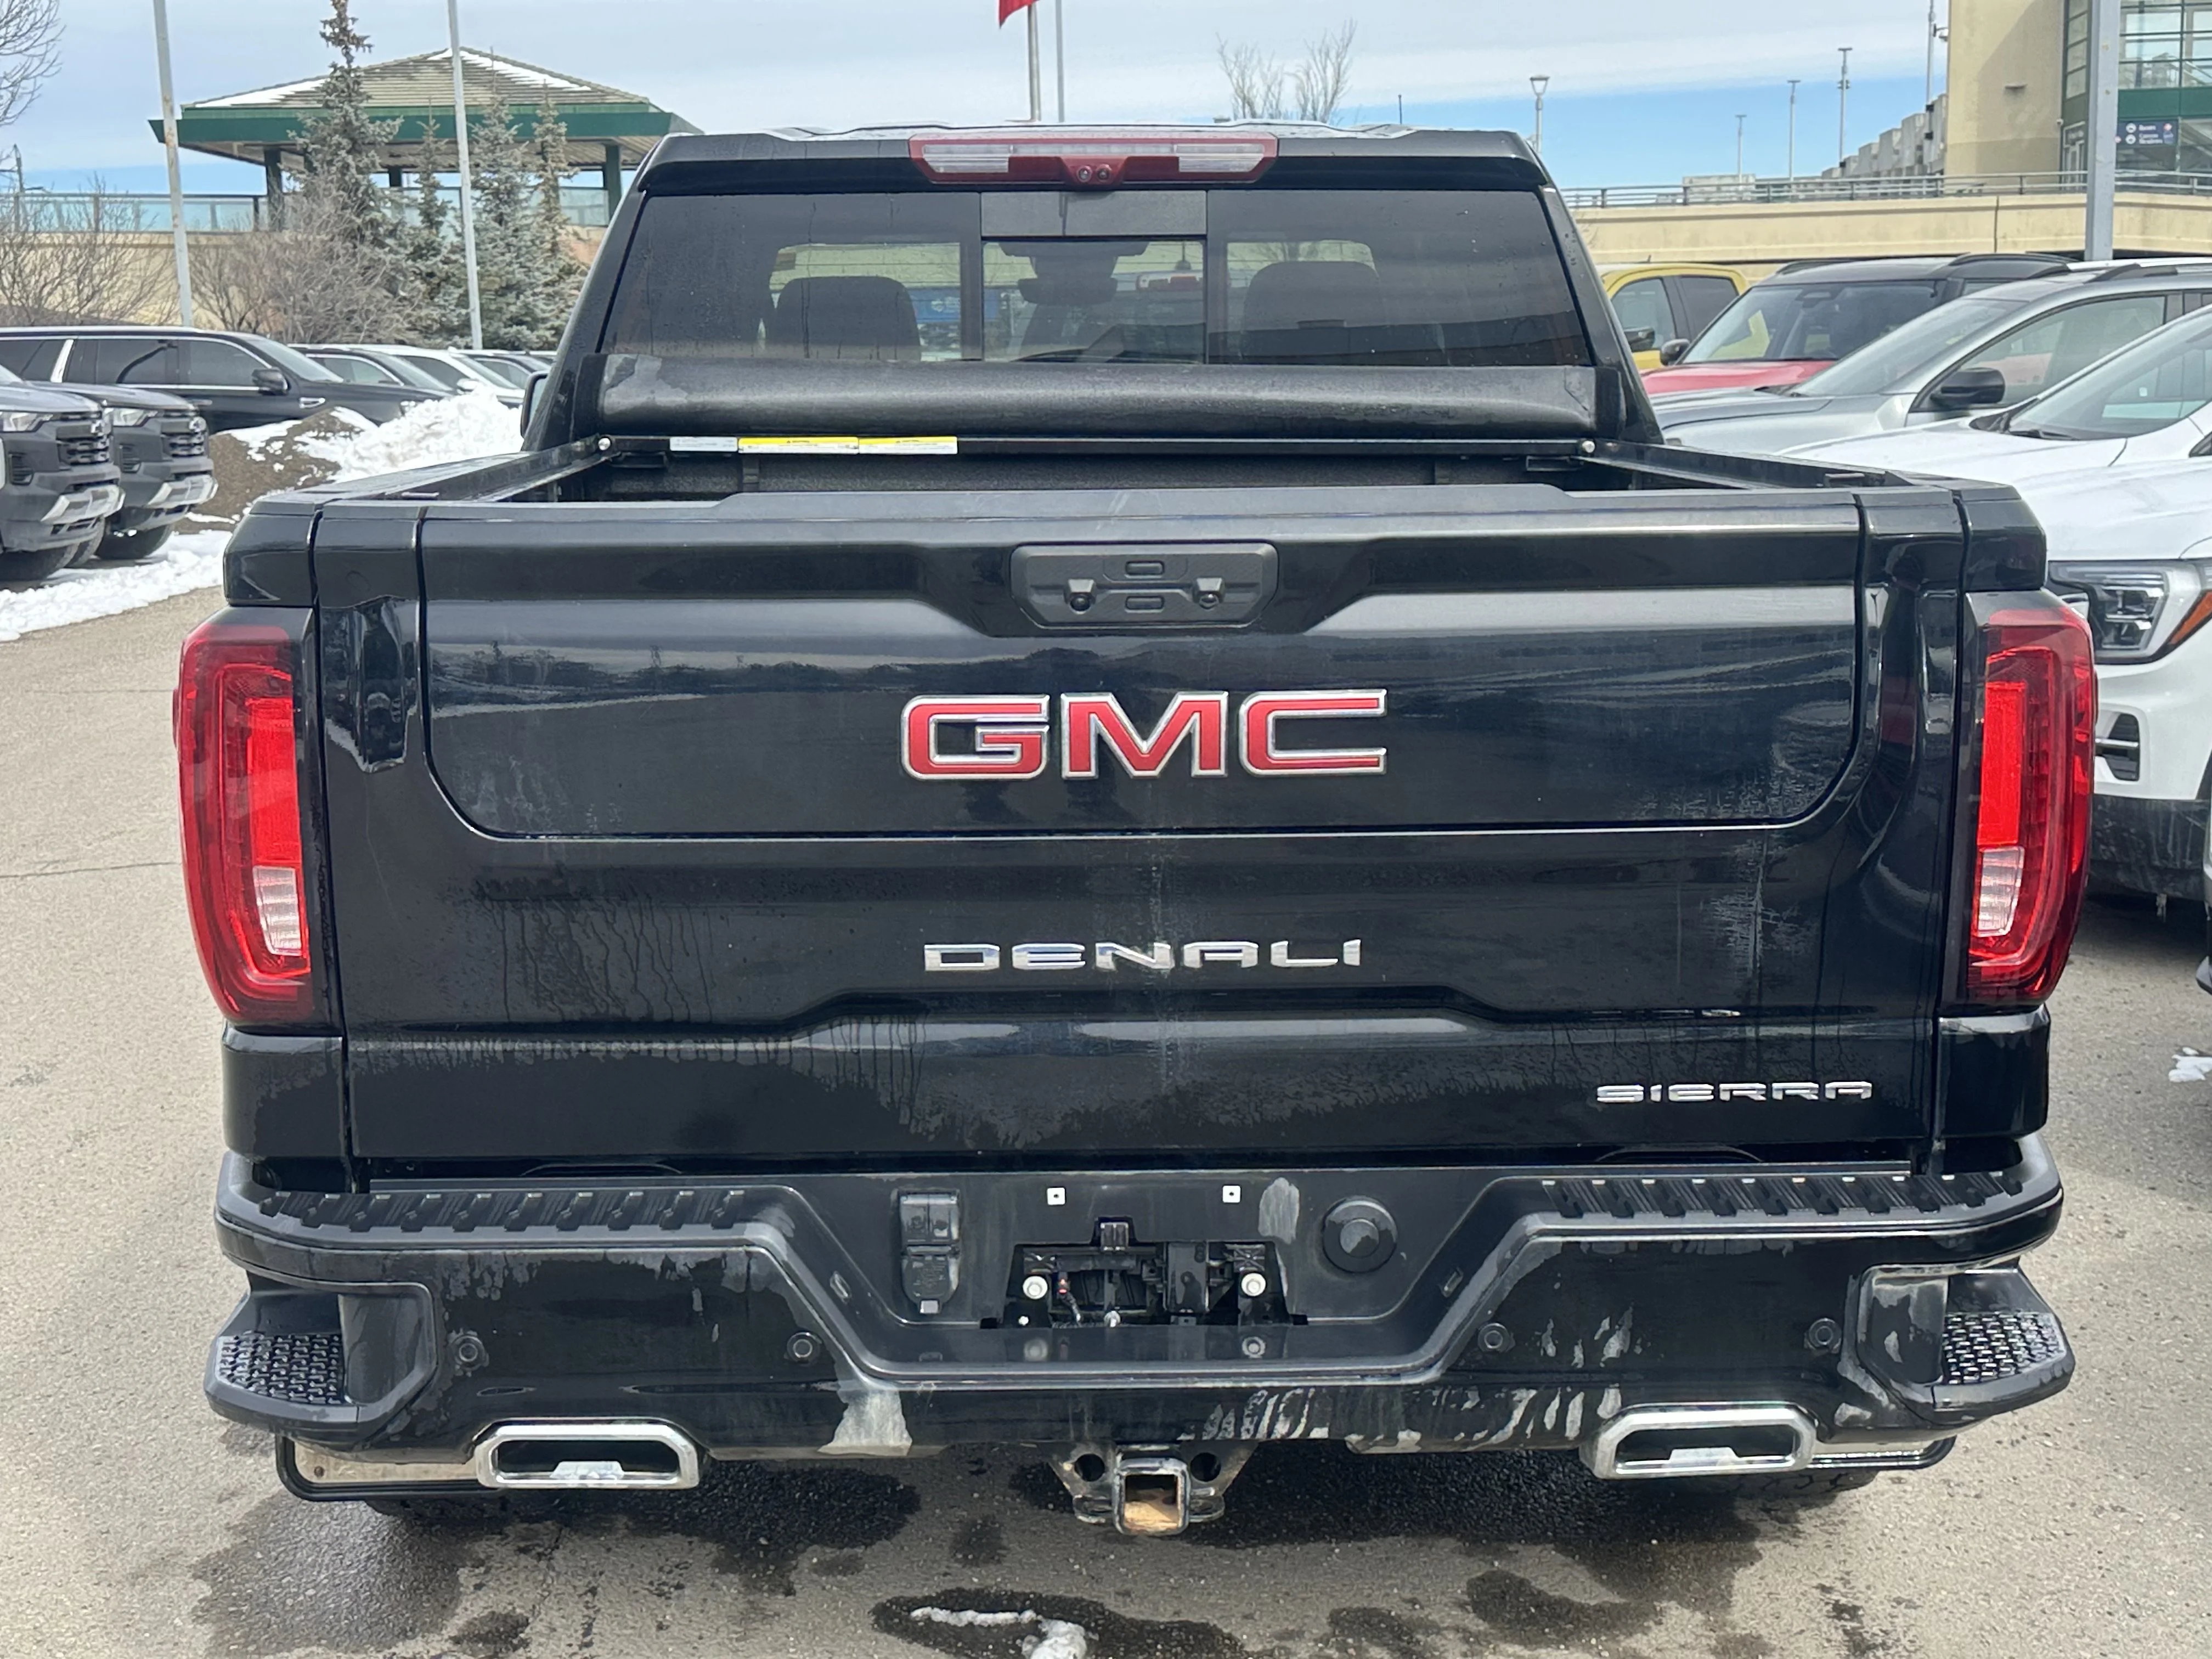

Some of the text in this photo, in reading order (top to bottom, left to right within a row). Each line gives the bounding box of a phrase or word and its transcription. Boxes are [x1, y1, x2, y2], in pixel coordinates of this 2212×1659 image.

[901, 689, 1387, 781] GMC
[924, 939, 1362, 972] DENALI
[1596, 1081, 1873, 1103] SIERRA
